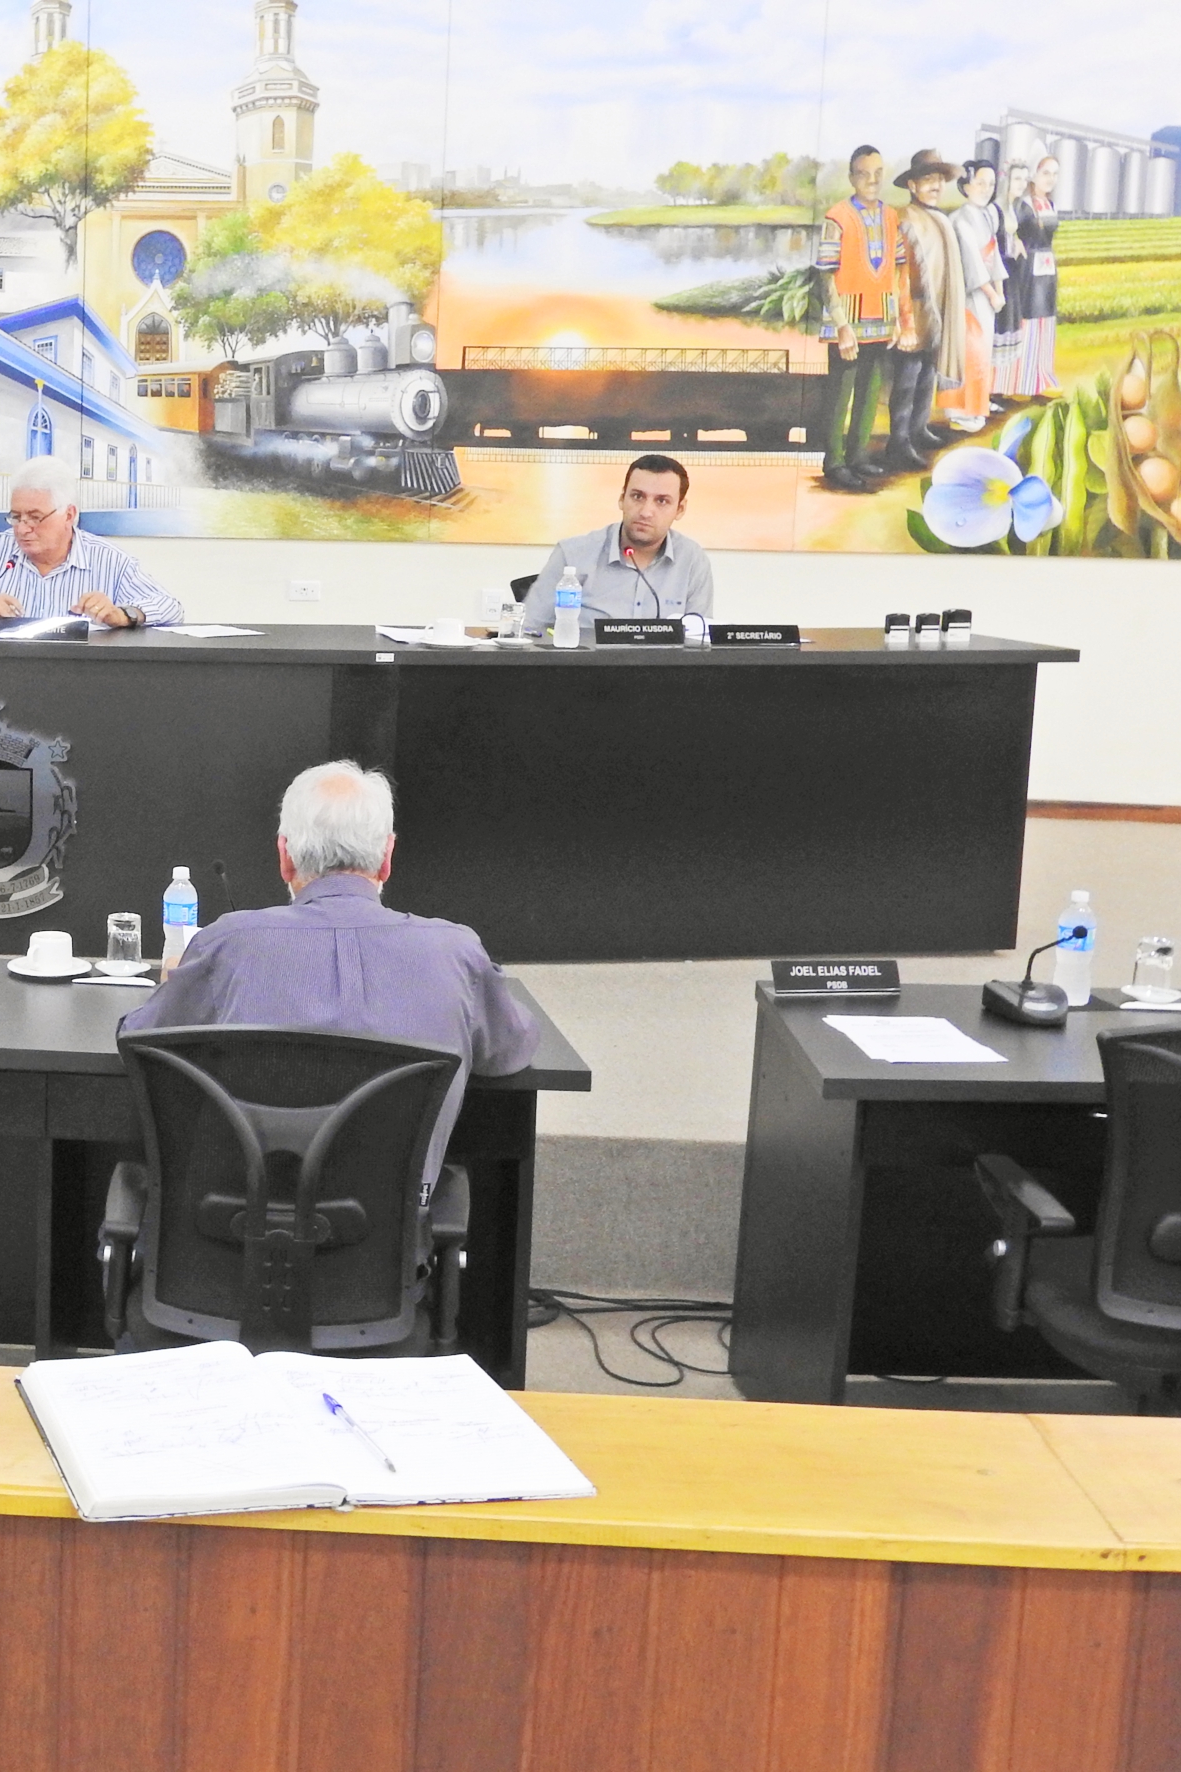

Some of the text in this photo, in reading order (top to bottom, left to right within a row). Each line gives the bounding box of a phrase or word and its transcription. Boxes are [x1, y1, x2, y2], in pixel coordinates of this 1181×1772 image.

[603, 624, 642, 632] MAURÍCIO
[735, 630, 783, 640] SECRETÁRIO
[790, 965, 882, 976] JOEL ELIAS FADEL
[826, 981, 848, 989] PSDB
